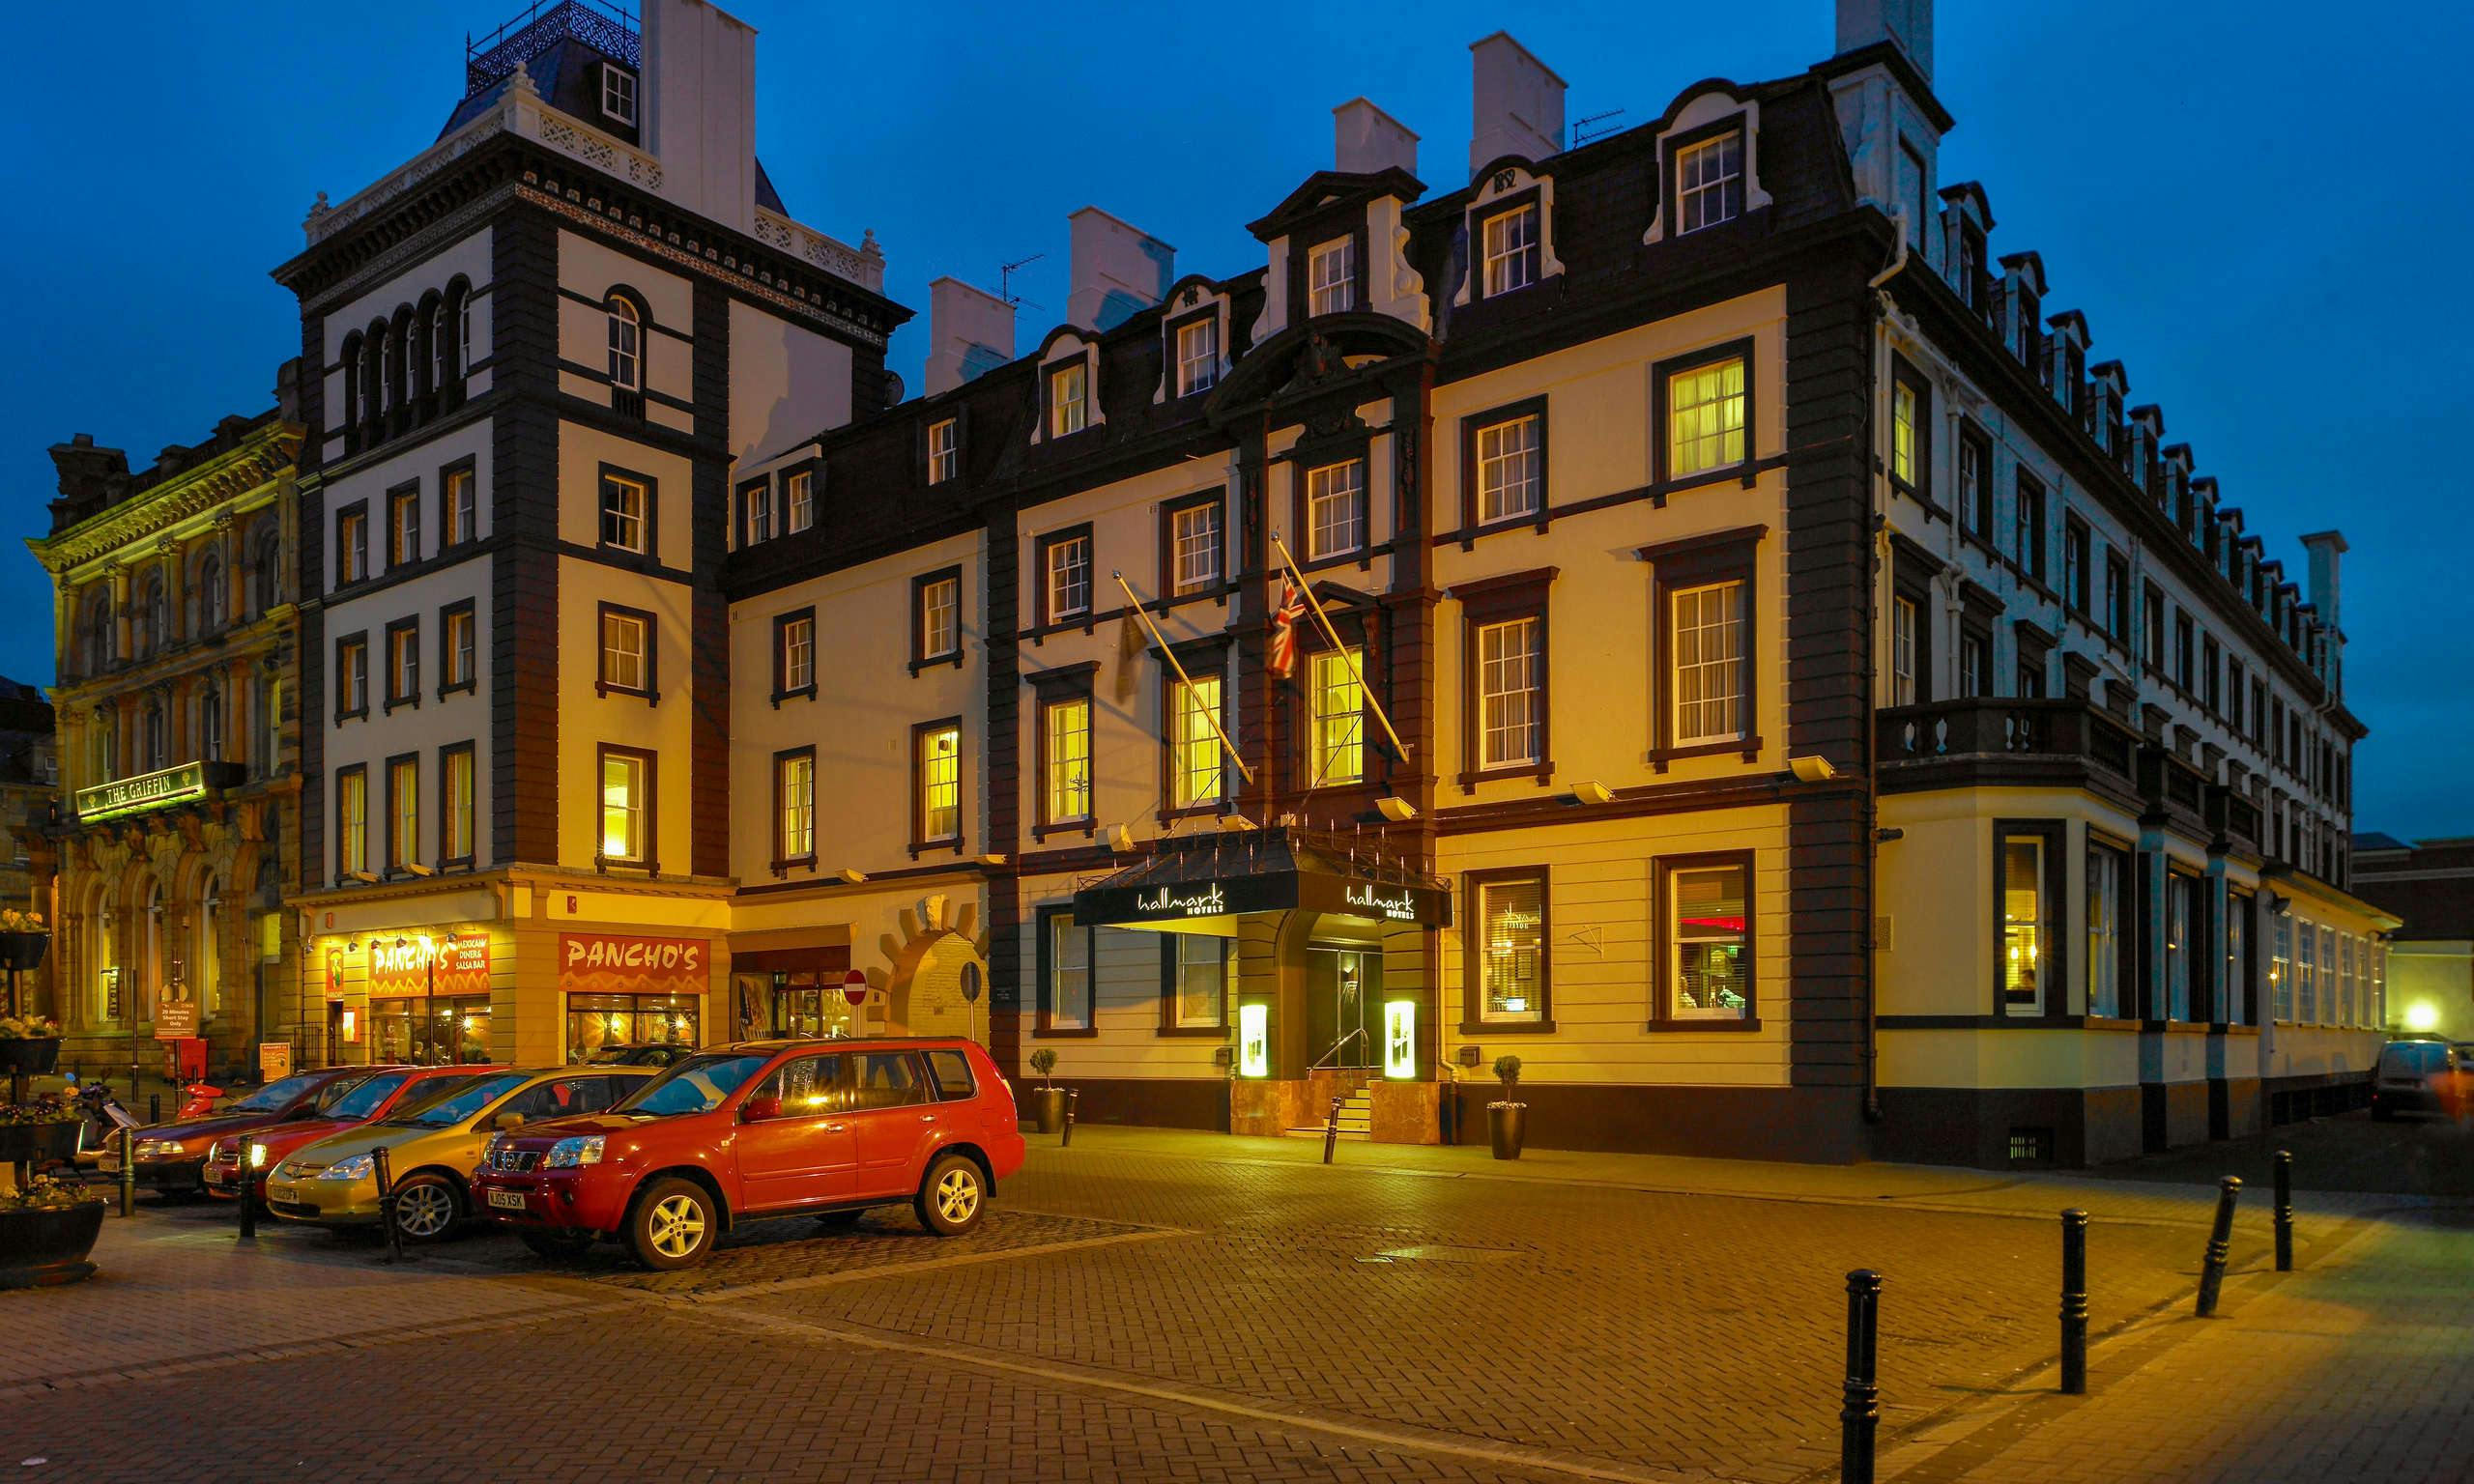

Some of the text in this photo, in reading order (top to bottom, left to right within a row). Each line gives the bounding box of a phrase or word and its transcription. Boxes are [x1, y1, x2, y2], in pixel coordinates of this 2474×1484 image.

[106, 776, 171, 804] THE GRIFFIN
[1137, 882, 1223, 910] hallmark
[1346, 884, 1414, 912] hallmark
[1187, 905, 1223, 915] HOTELS
[1386, 909, 1415, 920] HOTELS
[457, 938, 487, 951] MEXICAN
[566, 940, 699, 970] PANCHO'S
[455, 959, 486, 970] SALSA BAR
[507, 1194, 523, 1207] XSK
